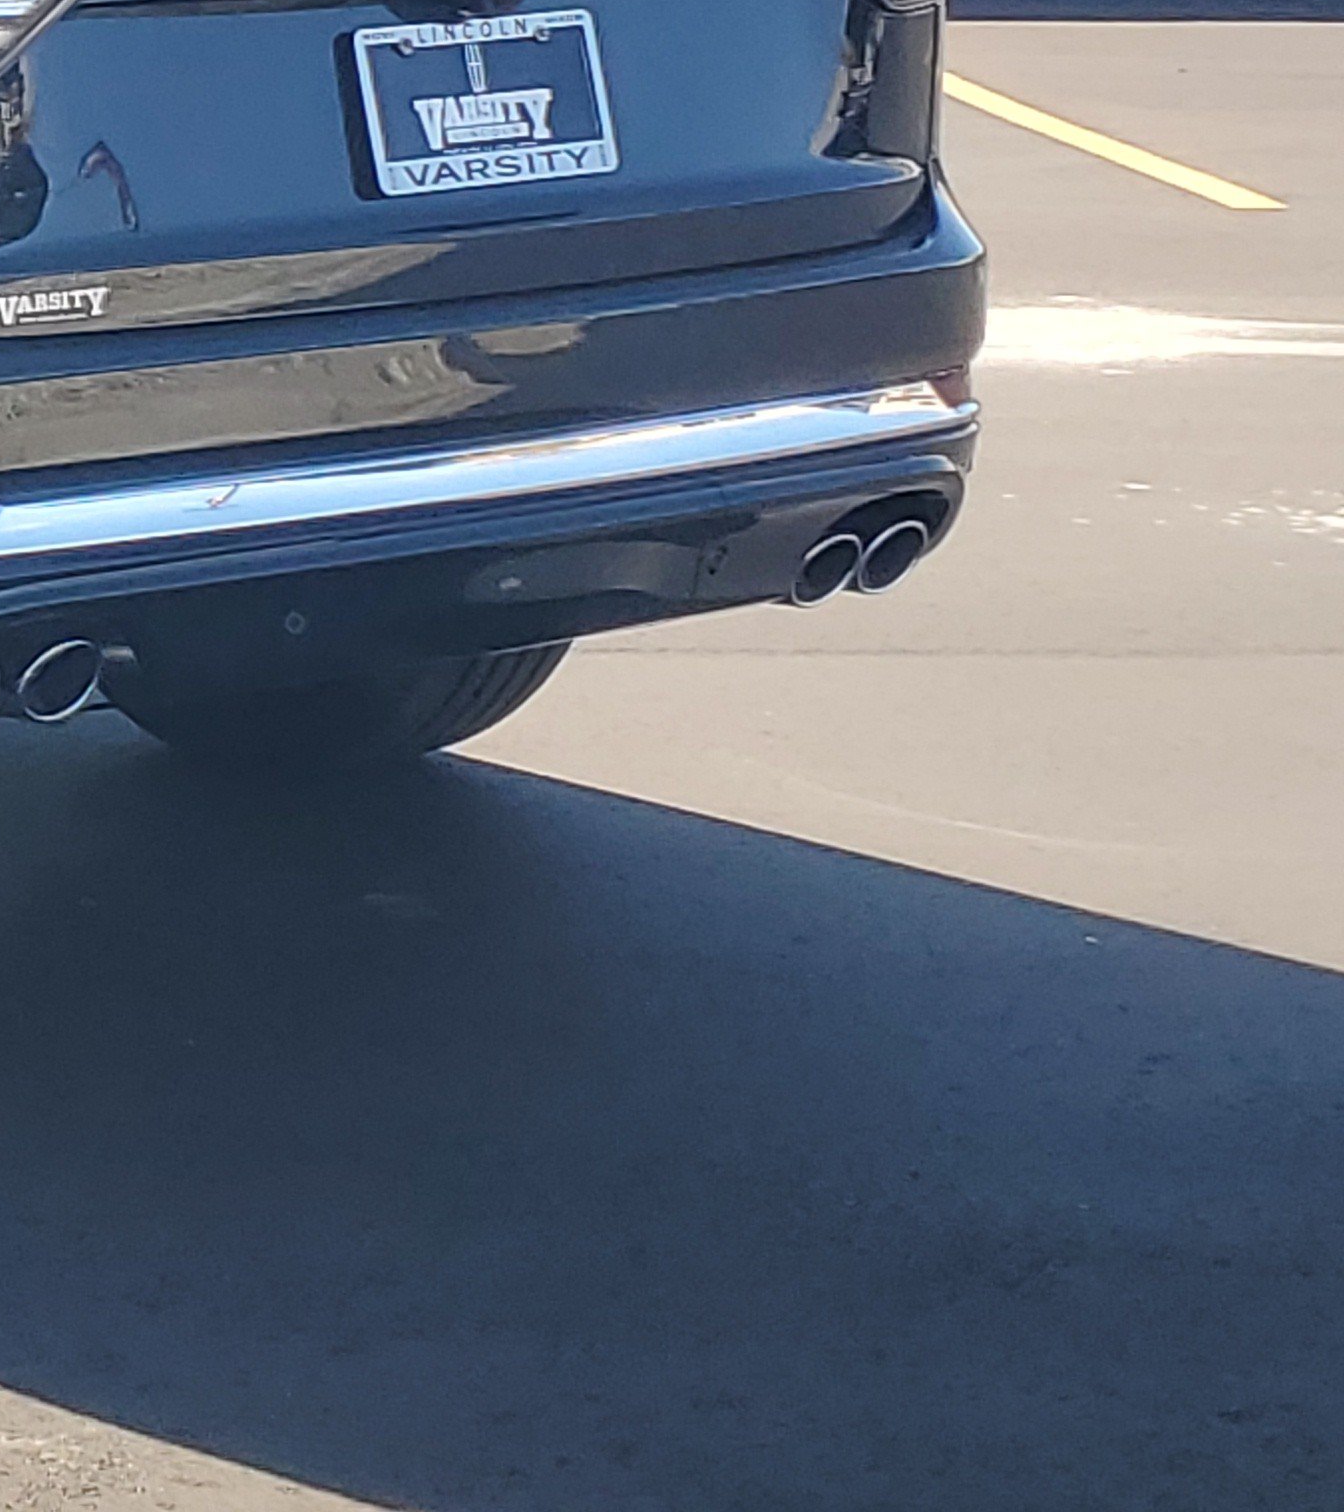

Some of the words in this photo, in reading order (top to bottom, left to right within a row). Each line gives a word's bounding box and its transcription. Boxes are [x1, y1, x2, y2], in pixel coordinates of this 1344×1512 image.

[417, 18, 528, 44] LINCOLN
[413, 88, 553, 151] VARSITY
[405, 147, 589, 187] VARSITY
